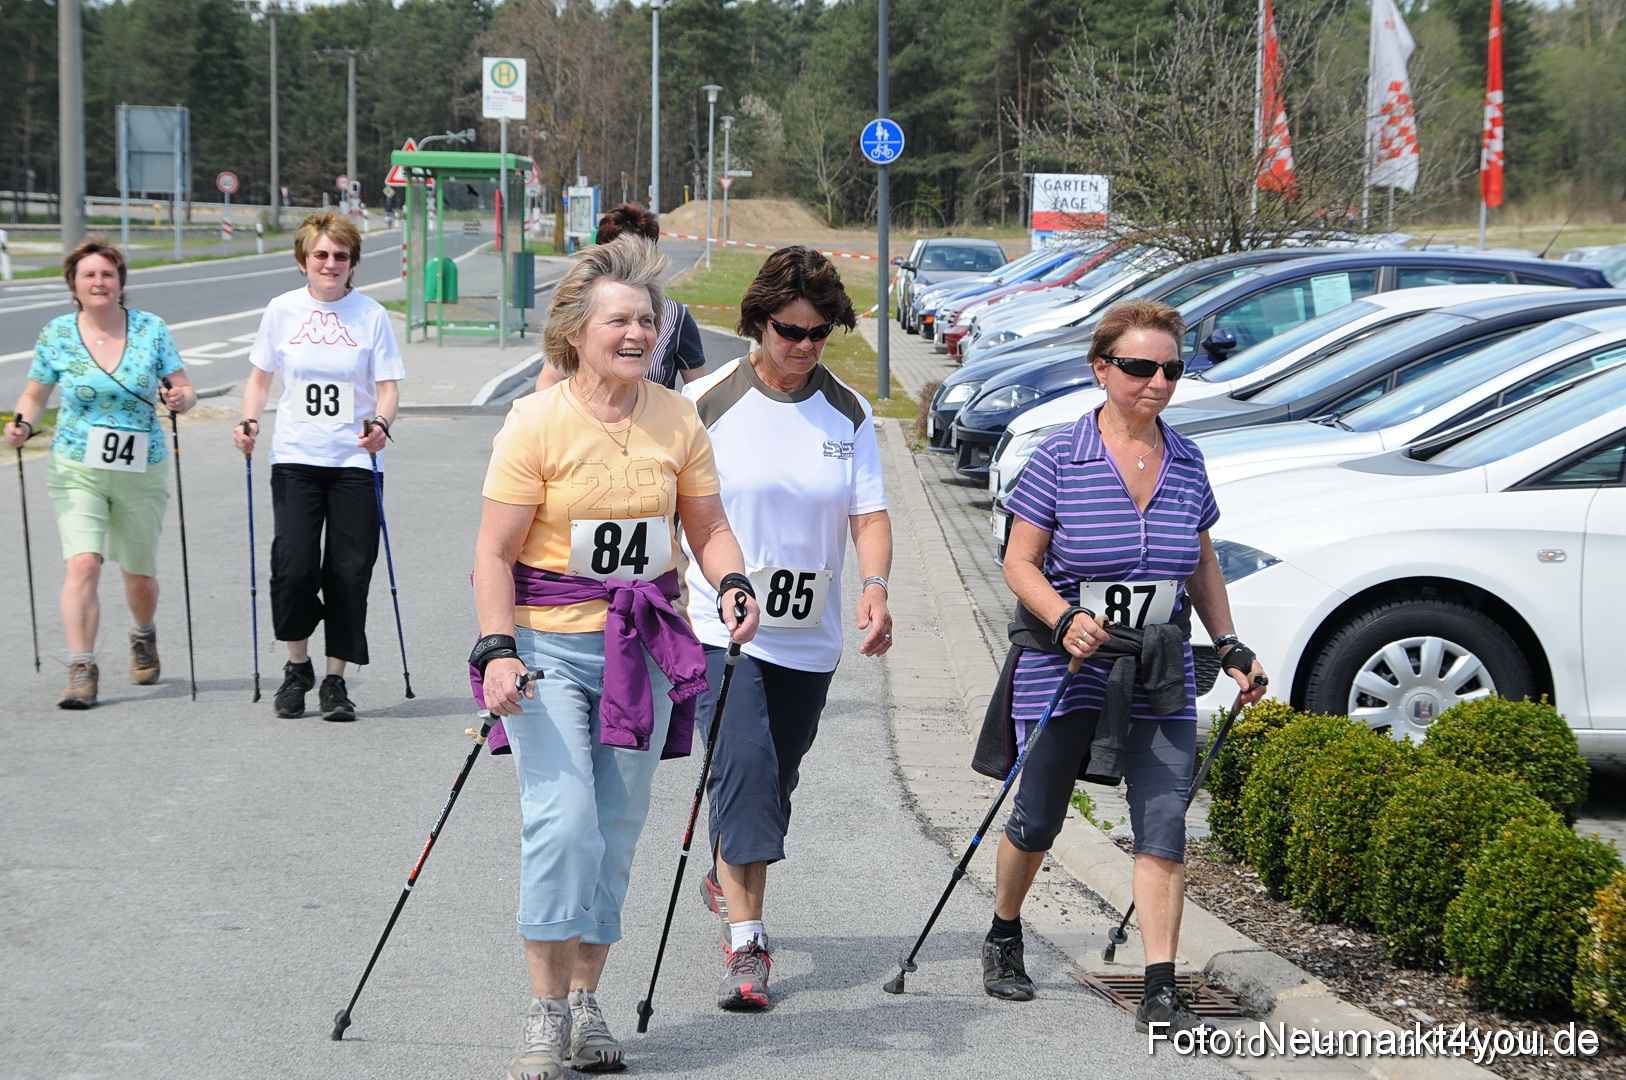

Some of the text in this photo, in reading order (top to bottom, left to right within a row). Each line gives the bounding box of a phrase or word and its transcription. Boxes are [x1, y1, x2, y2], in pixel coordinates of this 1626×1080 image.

[498, 65, 511, 82] H
[1043, 179, 1099, 192] GARTEN
[305, 383, 340, 417] 93
[102, 432, 135, 466] 94
[567, 457, 670, 520] 28
[591, 521, 650, 575] 84
[765, 569, 817, 621] 85
[1104, 583, 1157, 631] 87
